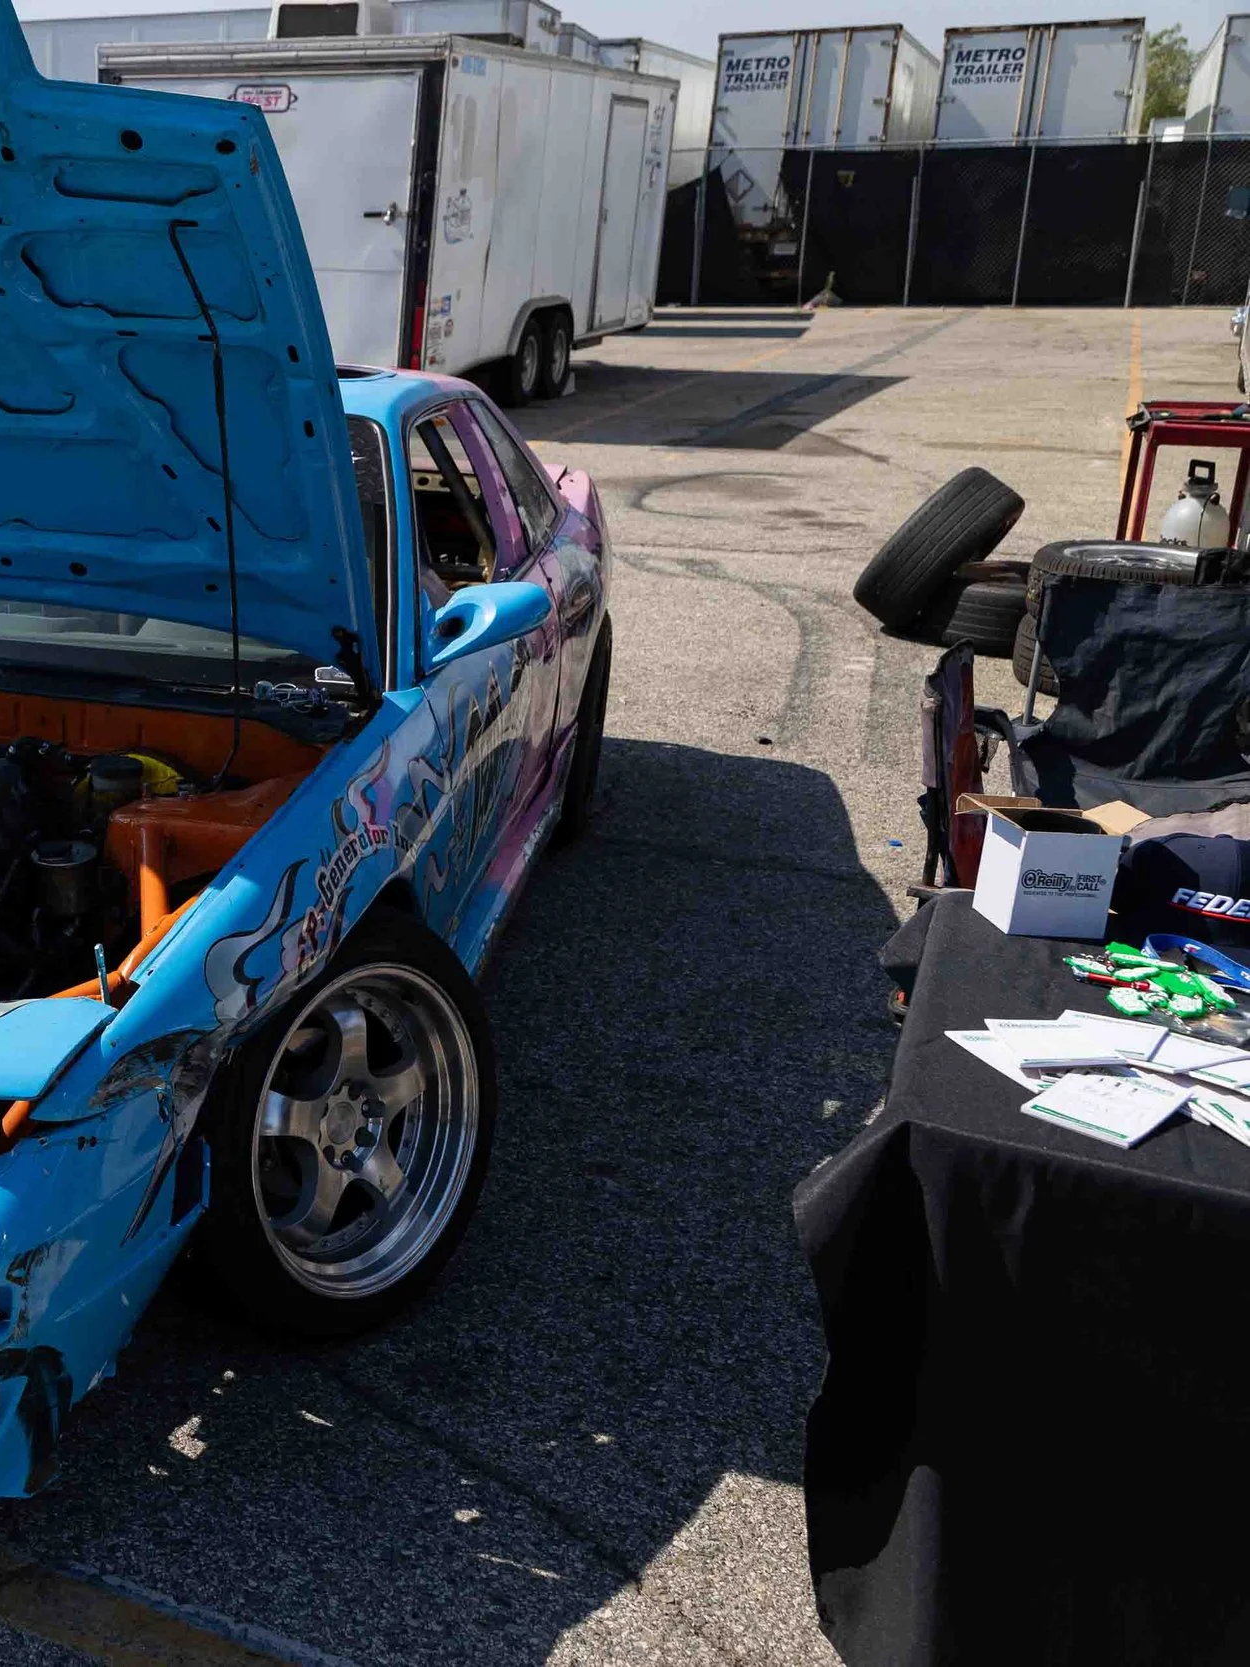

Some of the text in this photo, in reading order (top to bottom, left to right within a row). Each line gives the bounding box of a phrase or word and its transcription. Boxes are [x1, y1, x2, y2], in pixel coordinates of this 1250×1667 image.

[955, 47, 1026, 62] METRO
[725, 56, 790, 71] METRO
[955, 63, 1023, 75] TRAILER
[726, 71, 789, 83] TRAILER
[1077, 874, 1102, 883] FIRST
[1076, 882, 1100, 892] CALL
[1171, 887, 1250, 918] FEDE
